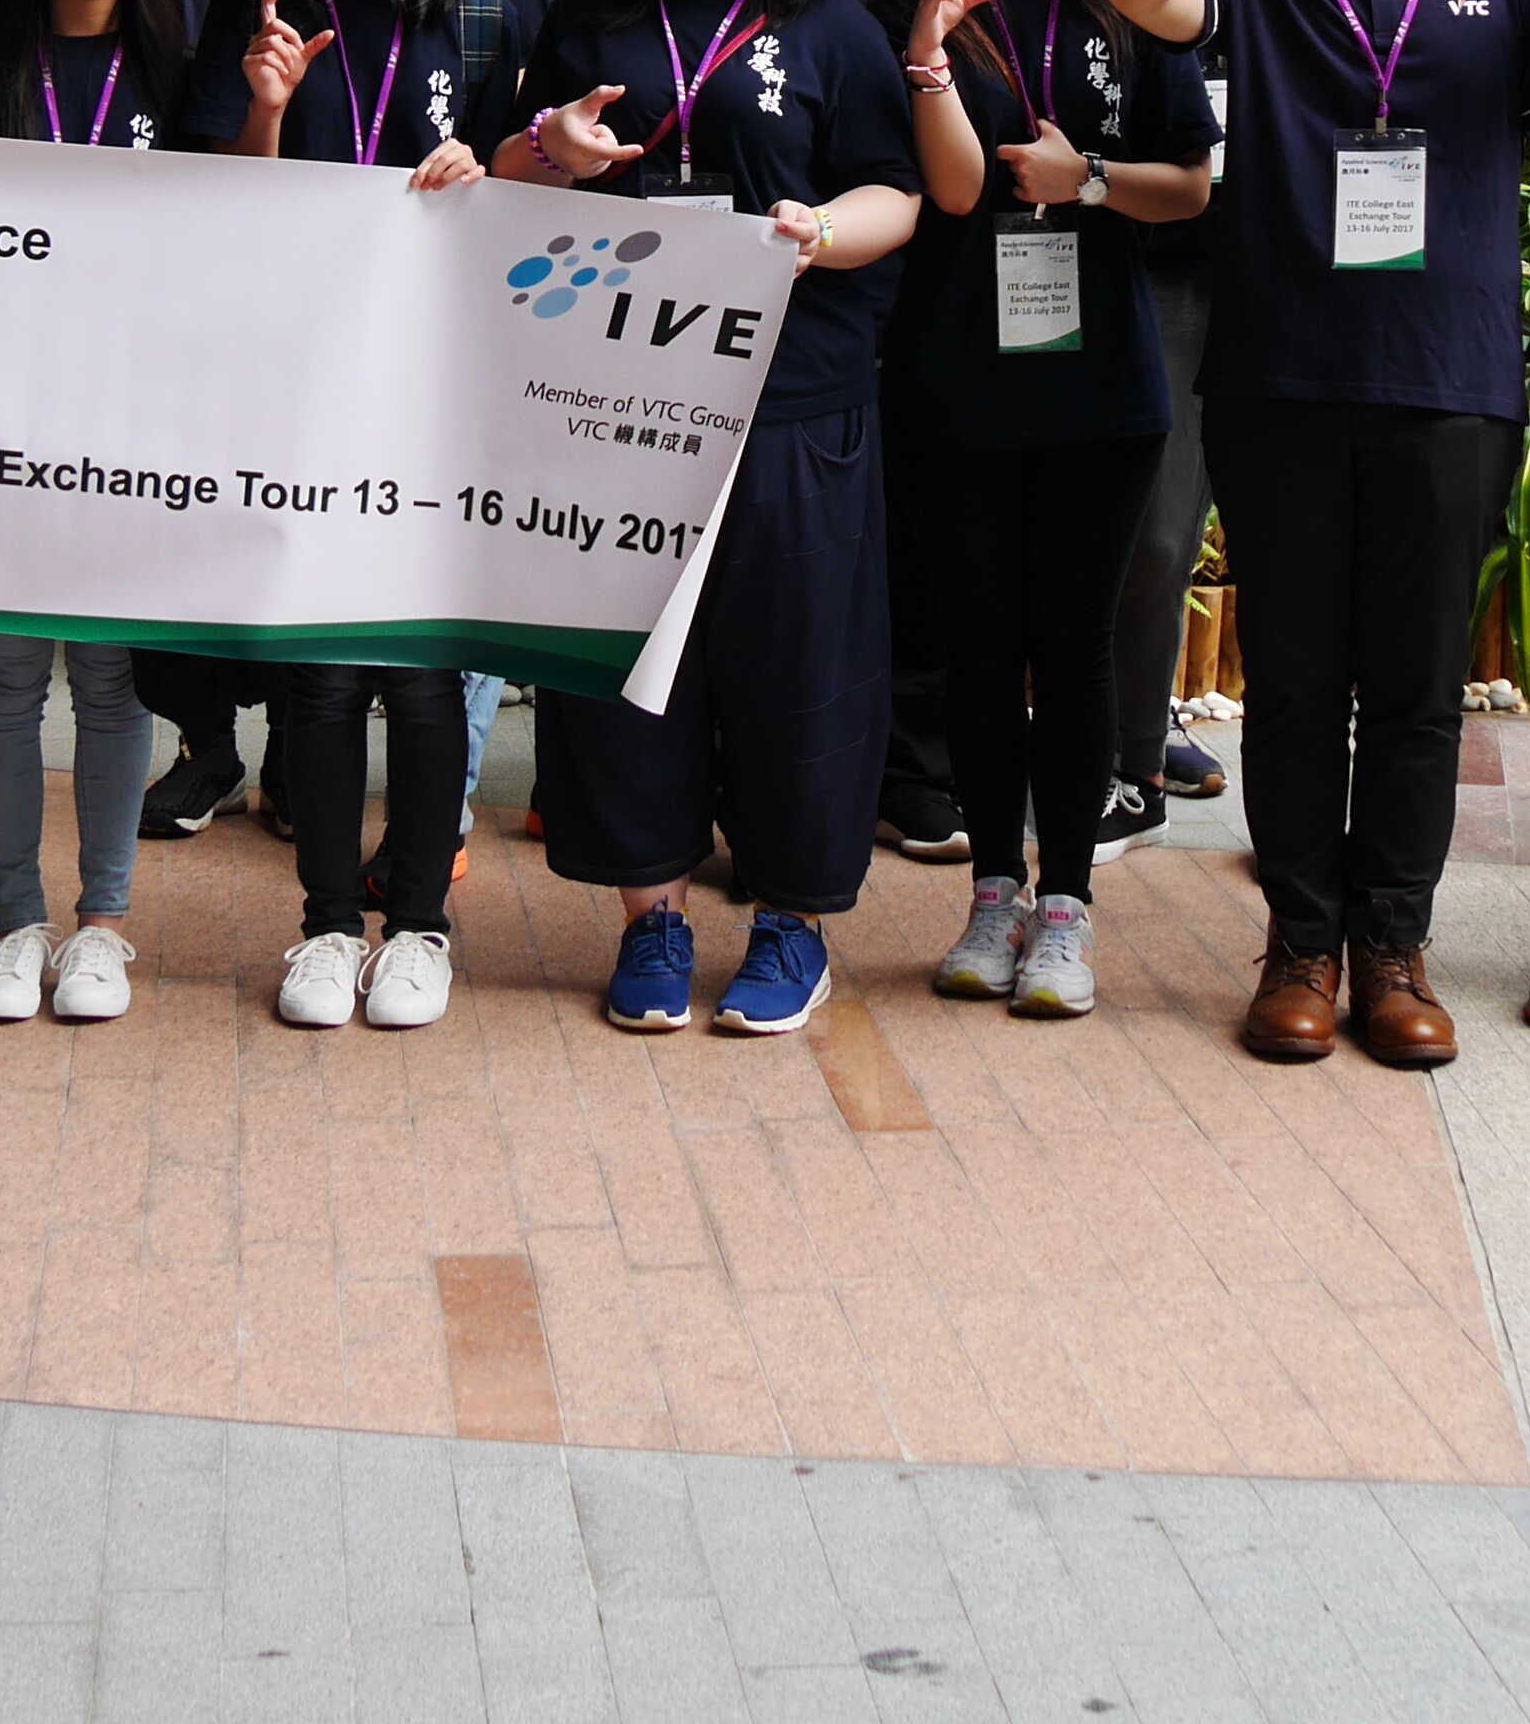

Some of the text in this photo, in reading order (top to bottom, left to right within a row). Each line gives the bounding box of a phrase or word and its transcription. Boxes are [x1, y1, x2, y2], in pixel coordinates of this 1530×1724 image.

[1349, 212, 1390, 221] Exchange
[1362, 200, 1394, 210] College
[604, 291, 762, 360] IVE
[524, 379, 745, 436] Member of VTC Group
[567, 417, 703, 456] VTC 機構成員
[235, 469, 338, 514] Tour
[353, 478, 399, 516] 13
[457, 485, 503, 526] 16
[516, 496, 604, 552] July
